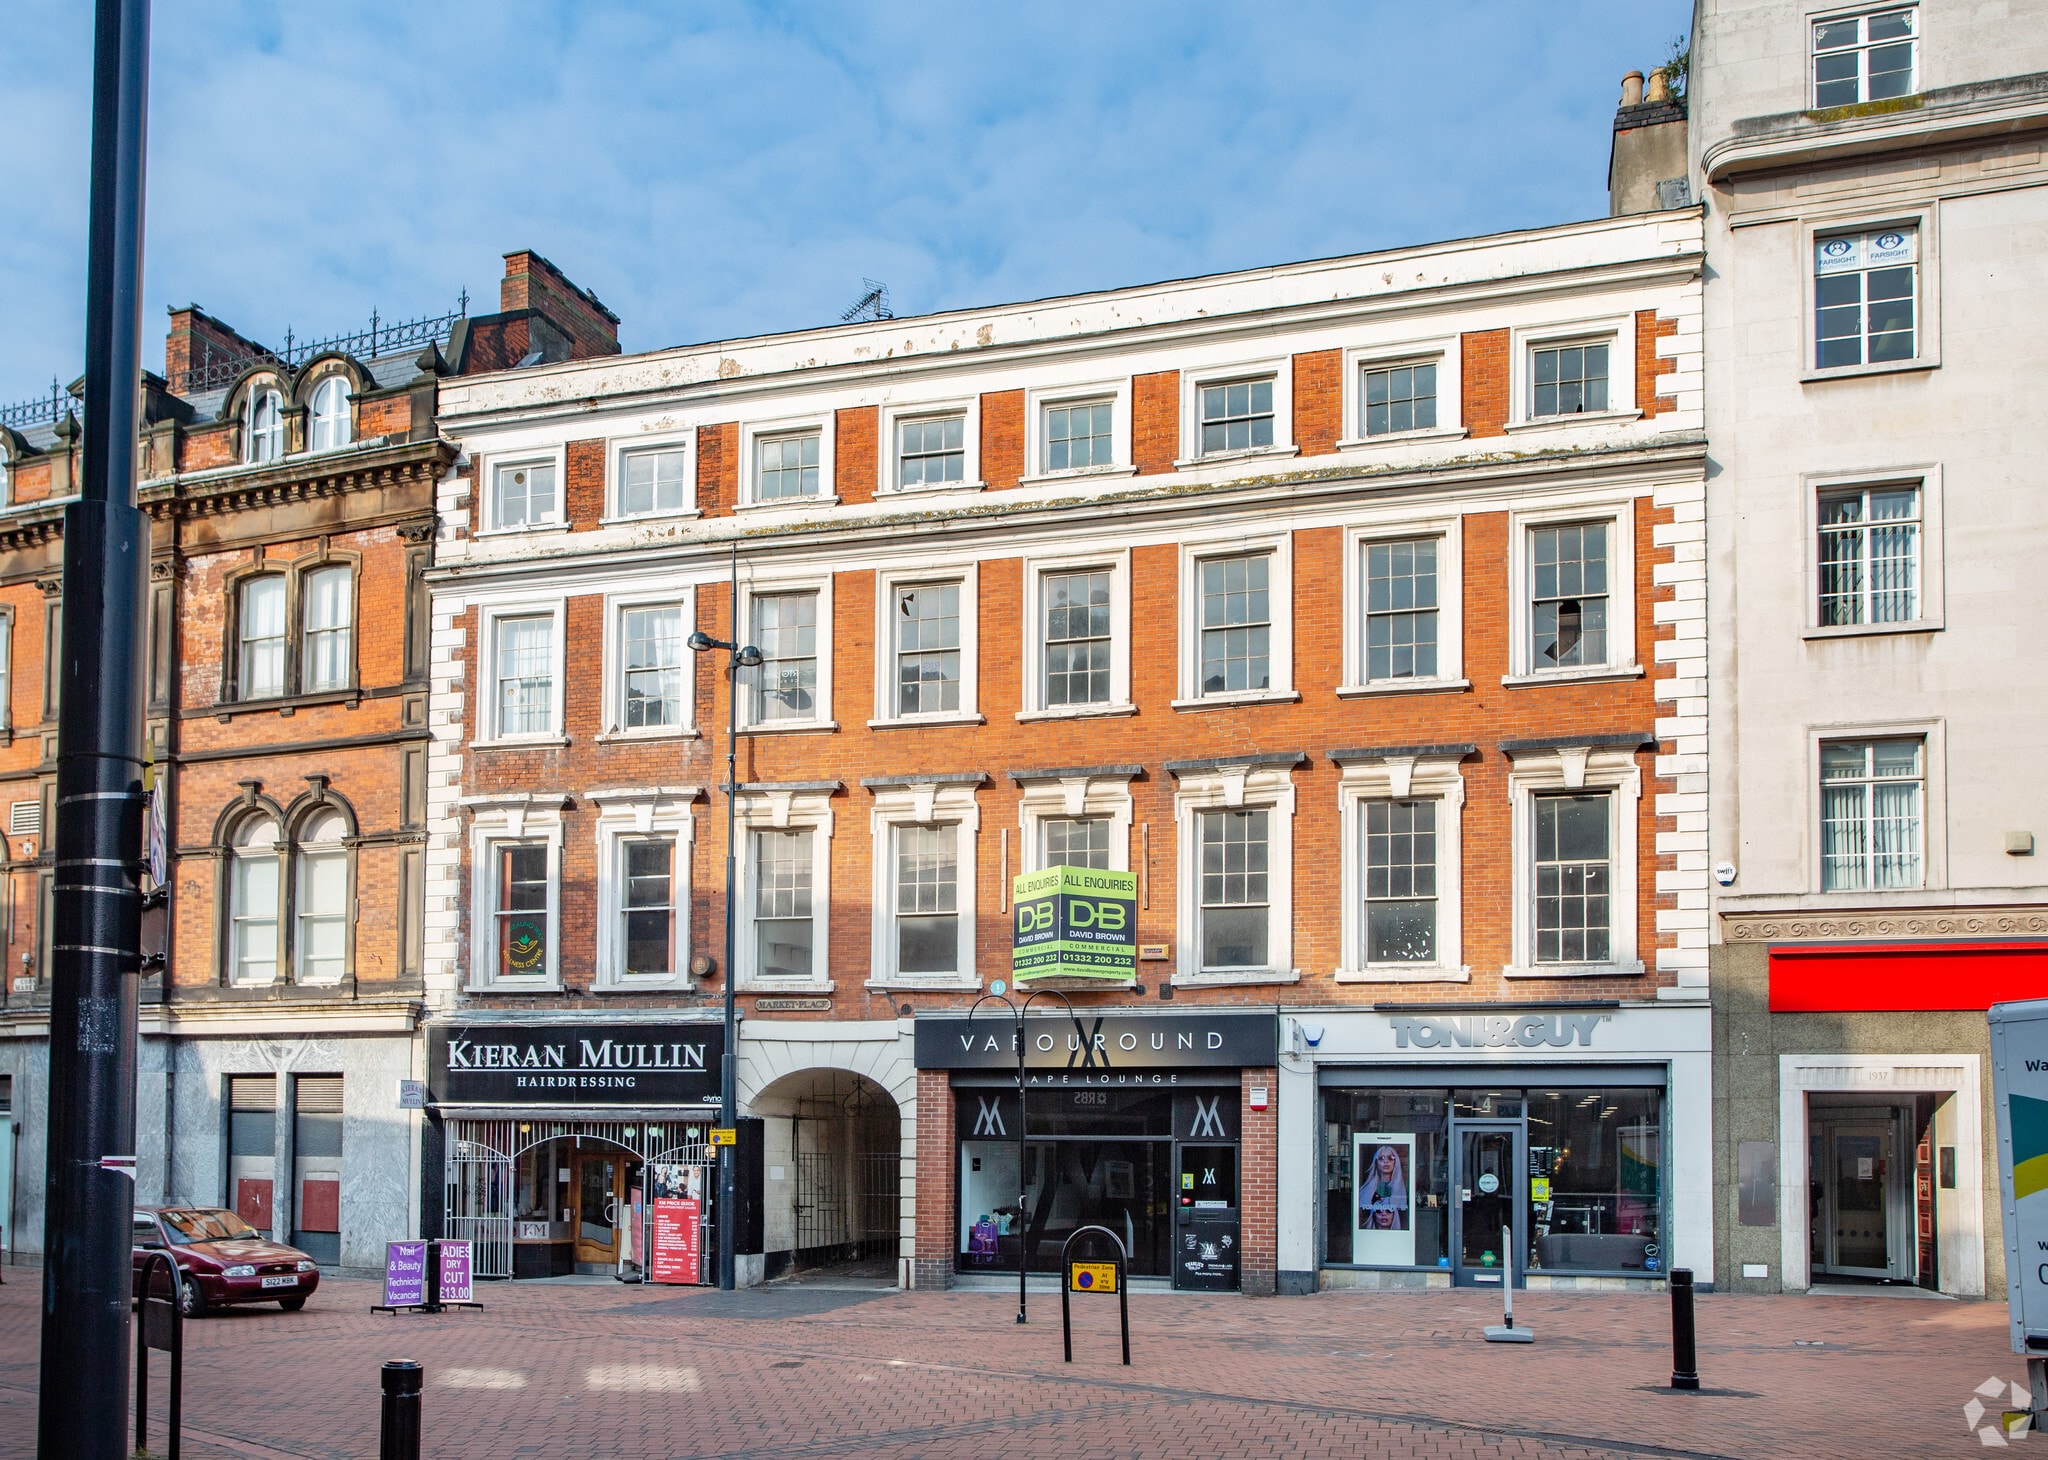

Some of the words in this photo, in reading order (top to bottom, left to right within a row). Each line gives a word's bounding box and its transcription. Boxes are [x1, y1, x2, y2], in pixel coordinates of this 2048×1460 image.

[1870, 249, 1908, 258] FARSIGHT
[1818, 256, 1856, 266] FARSIGHT
[1016, 884, 1026, 894] ALL
[1028, 875, 1058, 892] ENQUIRIES
[1064, 875, 1081, 886] ALL
[1084, 876, 1134, 891] ENQUIRIES
[1018, 901, 1054, 933] DB
[1070, 900, 1126, 930] DB
[1018, 934, 1033, 944] DAVID
[1034, 931, 1054, 941] BROWN
[1070, 930, 1093, 939] DAVID
[1095, 932, 1126, 941] BROWN
[1018, 945, 1053, 955] COMMERCIAL
[1070, 944, 1125, 952] COMMERCIAL
[503, 948, 524, 968] WELLNESS
[526, 948, 544, 967] CENTRE
[1015, 958, 1032, 967] 01332
[1033, 956, 1044, 964] 200
[1046, 954, 1057, 962] 232
[1063, 954, 1092, 962] 01332
[1094, 955, 1112, 963] 200
[1063, 967, 1131, 976] www.davidbrownproperty.com
[1390, 1015, 1600, 1048] TONI&GUY
[447, 1040, 565, 1068] KIERAN
[579, 1040, 706, 1068] MULLIN
[1086, 1074, 1177, 1083] LOUNGE
[1869, 1072, 1888, 1080] 1937
[517, 1077, 636, 1087] HAIRDRESSING
[1482, 1097, 1491, 1111] 4
[523, 1224, 547, 1236] KM
[400, 1246, 415, 1256] Nail
[440, 1246, 470, 1258] ADIES
[390, 1261, 396, 1271] &
[398, 1261, 421, 1272] Beauty
[446, 1260, 461, 1268] DRY
[388, 1277, 421, 1286] Technician
[444, 1272, 464, 1283] CUT
[388, 1291, 420, 1300] Vacancies
